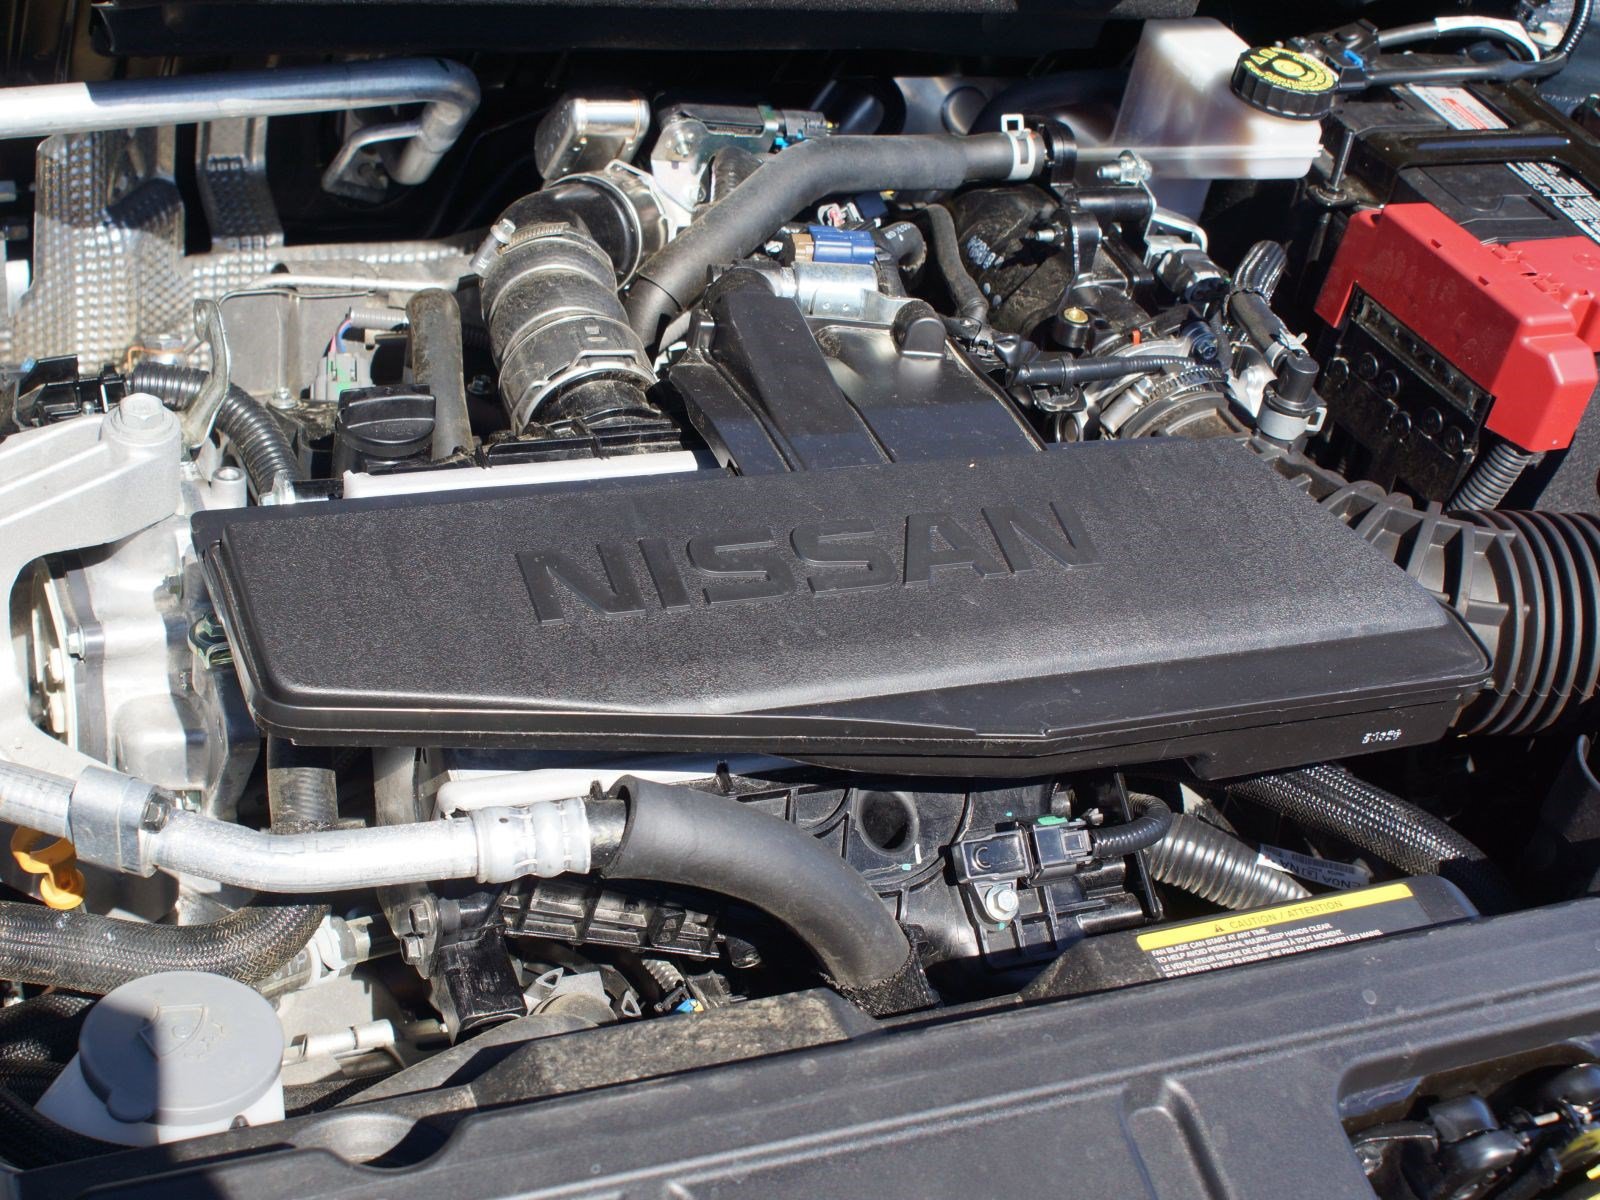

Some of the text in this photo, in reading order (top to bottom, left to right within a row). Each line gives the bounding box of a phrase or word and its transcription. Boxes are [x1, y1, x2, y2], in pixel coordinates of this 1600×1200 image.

[515, 500, 1103, 625] NISSAN
[1229, 913, 1277, 930] CAUTION
[1287, 900, 1343, 918] ATTENTION
[1151, 949, 1167, 957] FAN
[1166, 943, 1190, 954] BLADE
[1189, 941, 1206, 949] CAN
[1205, 936, 1228, 947] START
[1237, 931, 1251, 940] ANY
[1167, 952, 1185, 962] HELP
[1186, 948, 1207, 958] AVOID
[1207, 941, 1245, 954] PERSONAL
[1285, 927, 1309, 937] HANDS
[1347, 933, 1360, 942] LES
[1160, 964, 1171, 972] LE
[1170, 955, 1216, 970] VENTILATEUR
[1215, 949, 1242, 961] RISQUE
[1252, 939, 1290, 953] DÉMARRER
[1295, 936, 1313, 944] TOUT
